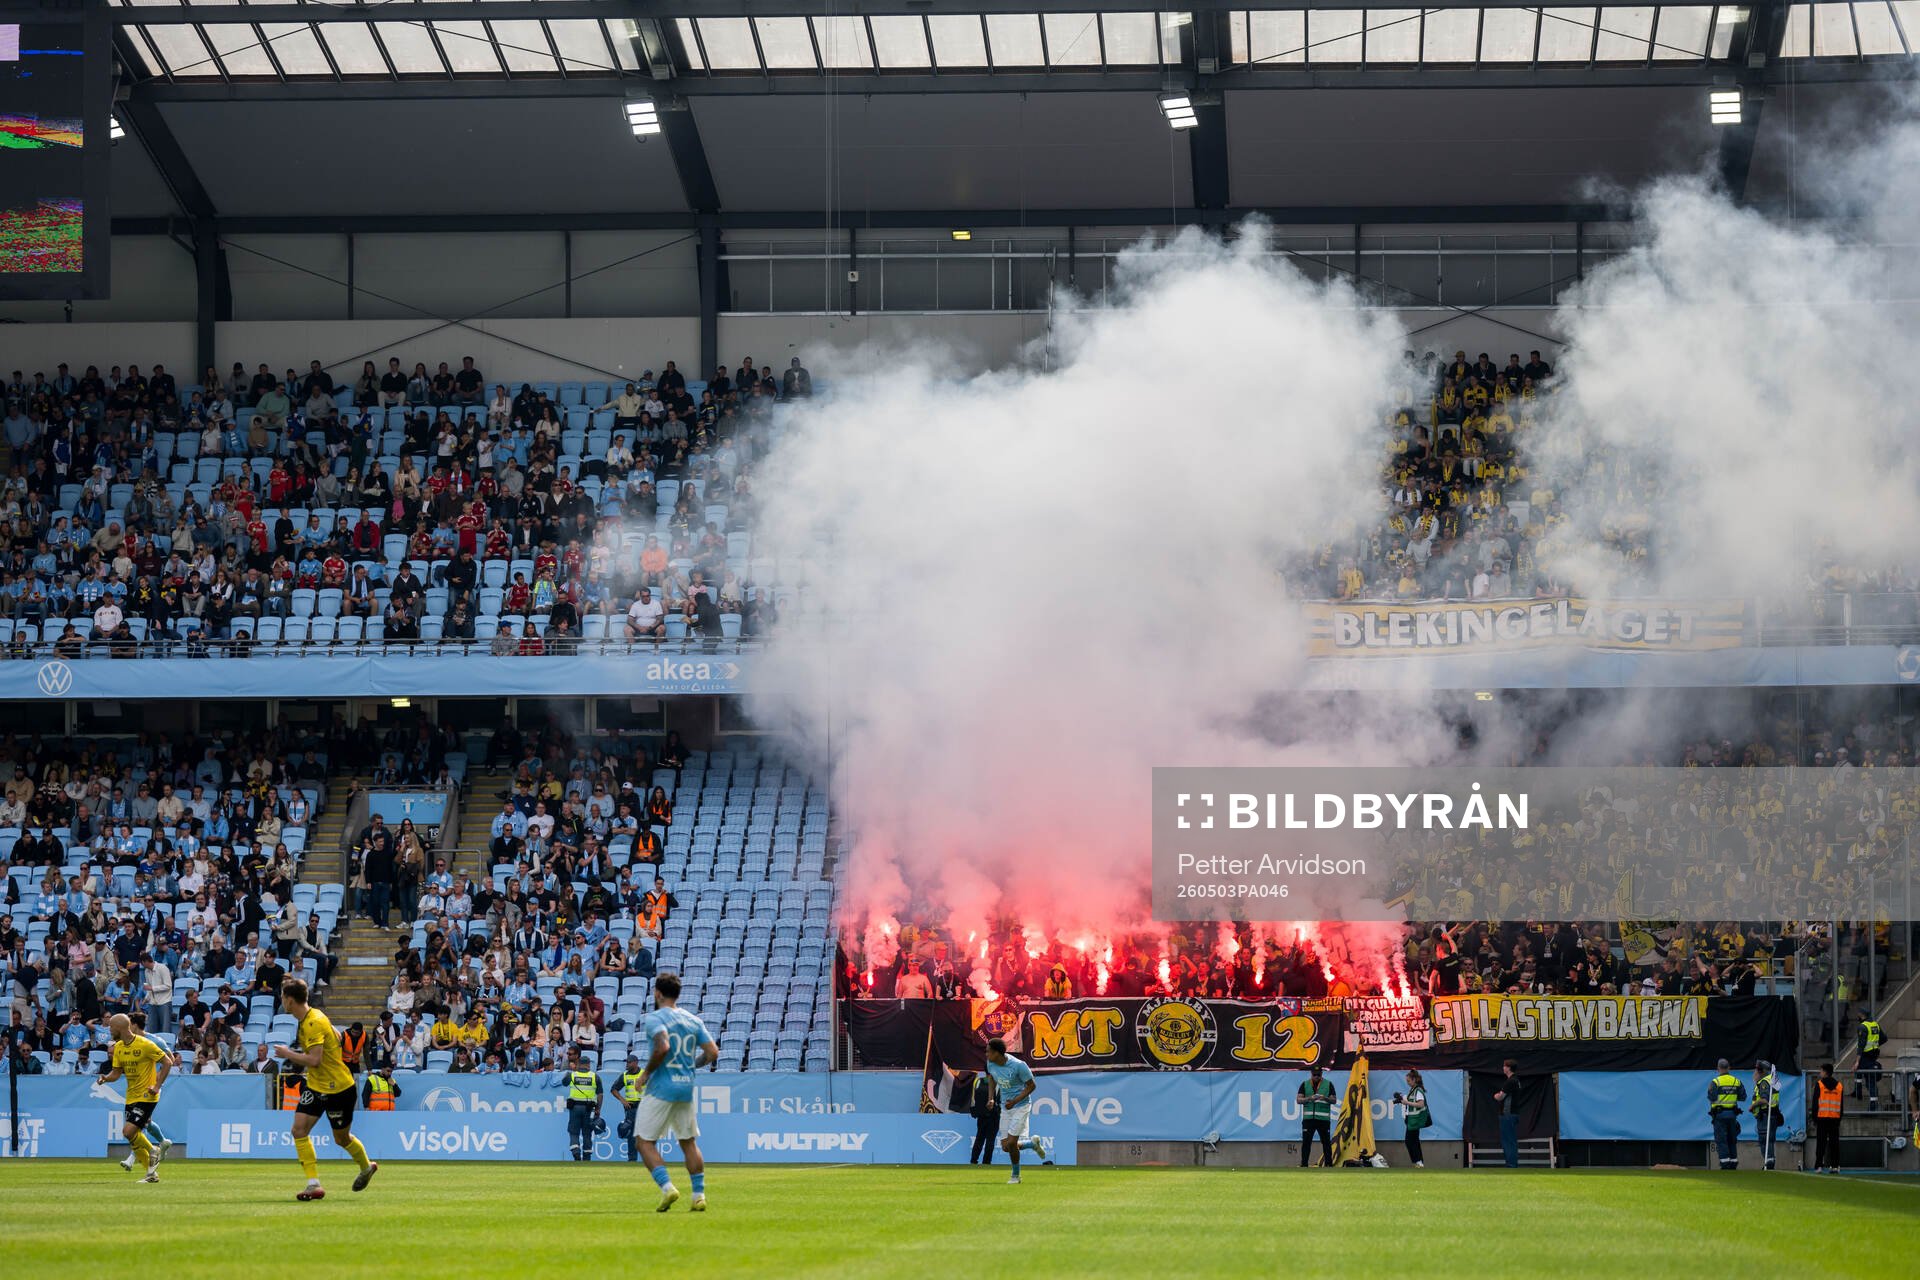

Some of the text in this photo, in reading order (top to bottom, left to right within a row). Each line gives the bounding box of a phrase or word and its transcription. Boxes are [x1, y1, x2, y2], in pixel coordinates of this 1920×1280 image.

[646, 657, 711, 680] akea
[1029, 1007, 1125, 1059] MT
[1231, 1013, 1321, 1066] 12
[666, 1033, 697, 1069] 29
[257, 1131, 330, 1146] LF Sne
[399, 1125, 508, 1154] visolve
[748, 1132, 869, 1150] MULTIPLY
[1130, 1144, 1143, 1156] 83
